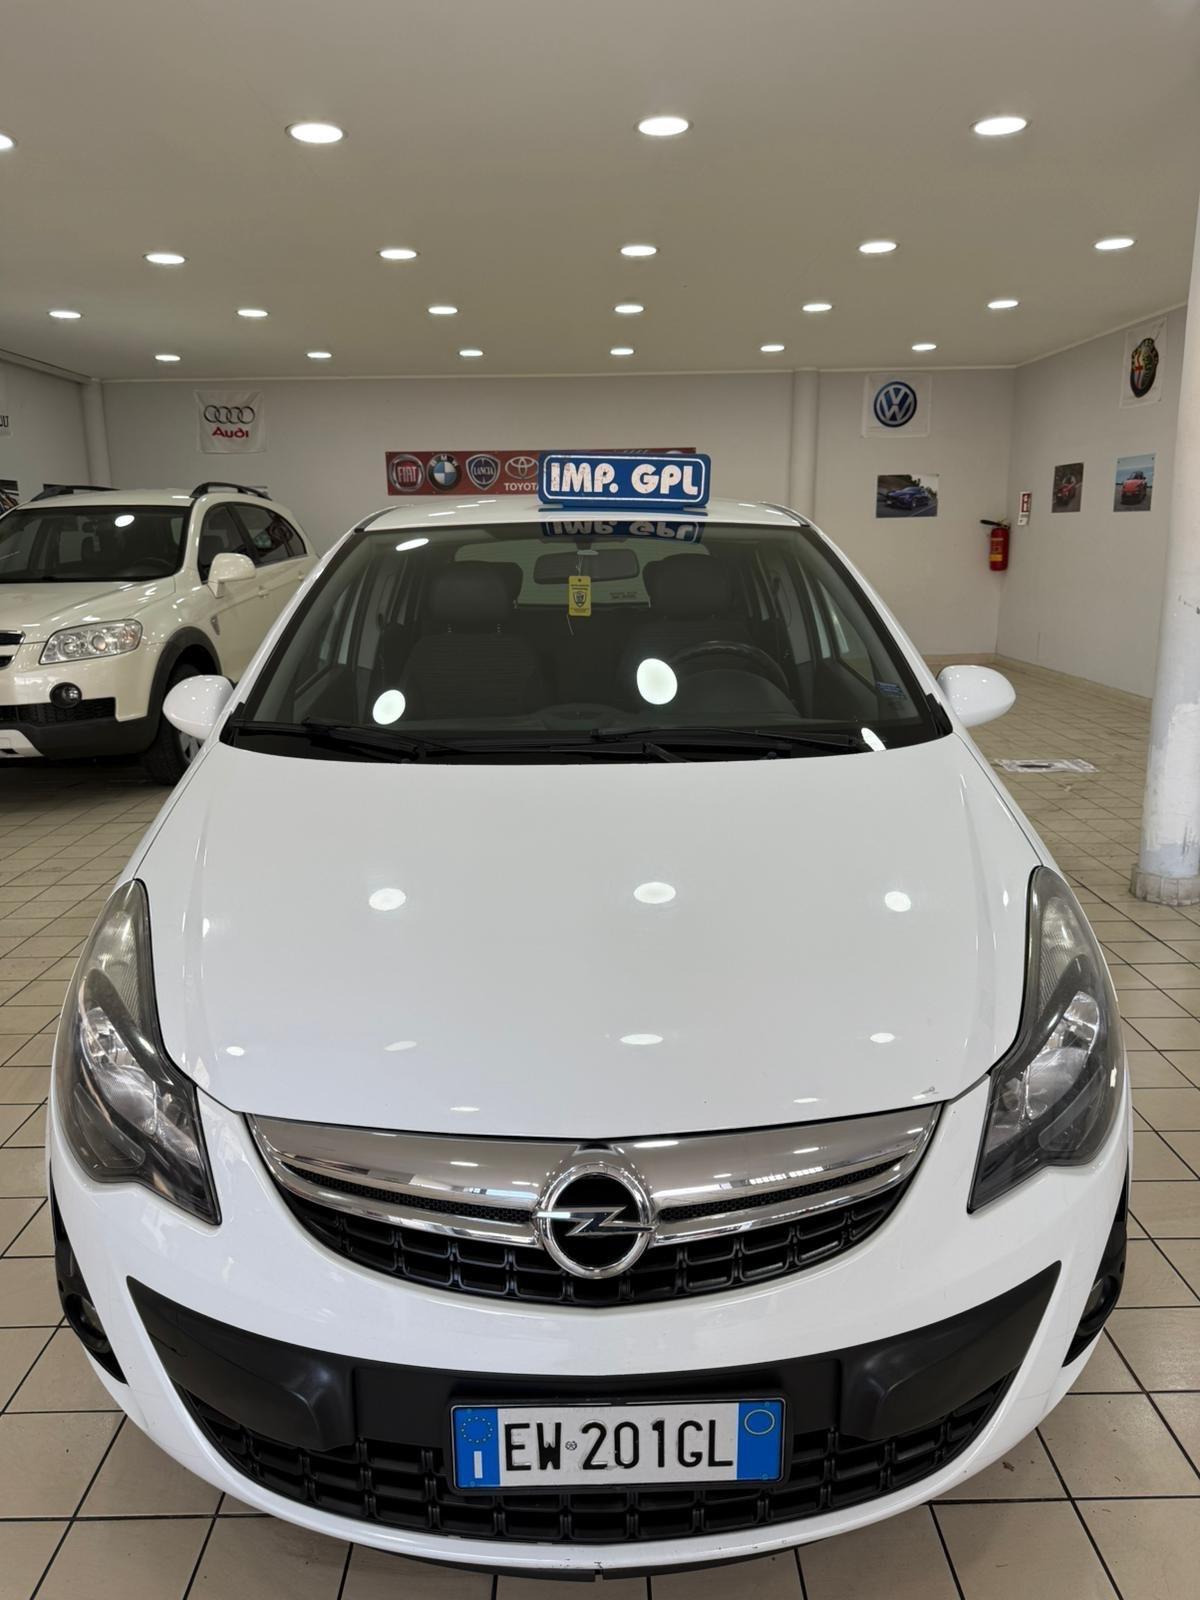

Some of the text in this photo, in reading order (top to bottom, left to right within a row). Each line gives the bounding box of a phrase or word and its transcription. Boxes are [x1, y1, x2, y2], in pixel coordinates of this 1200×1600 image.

[212, 426, 249, 438] Audi
[397, 466, 417, 483] FIAT
[550, 462, 699, 495] IMP. GPL
[504, 482, 538, 491] TOYOT
